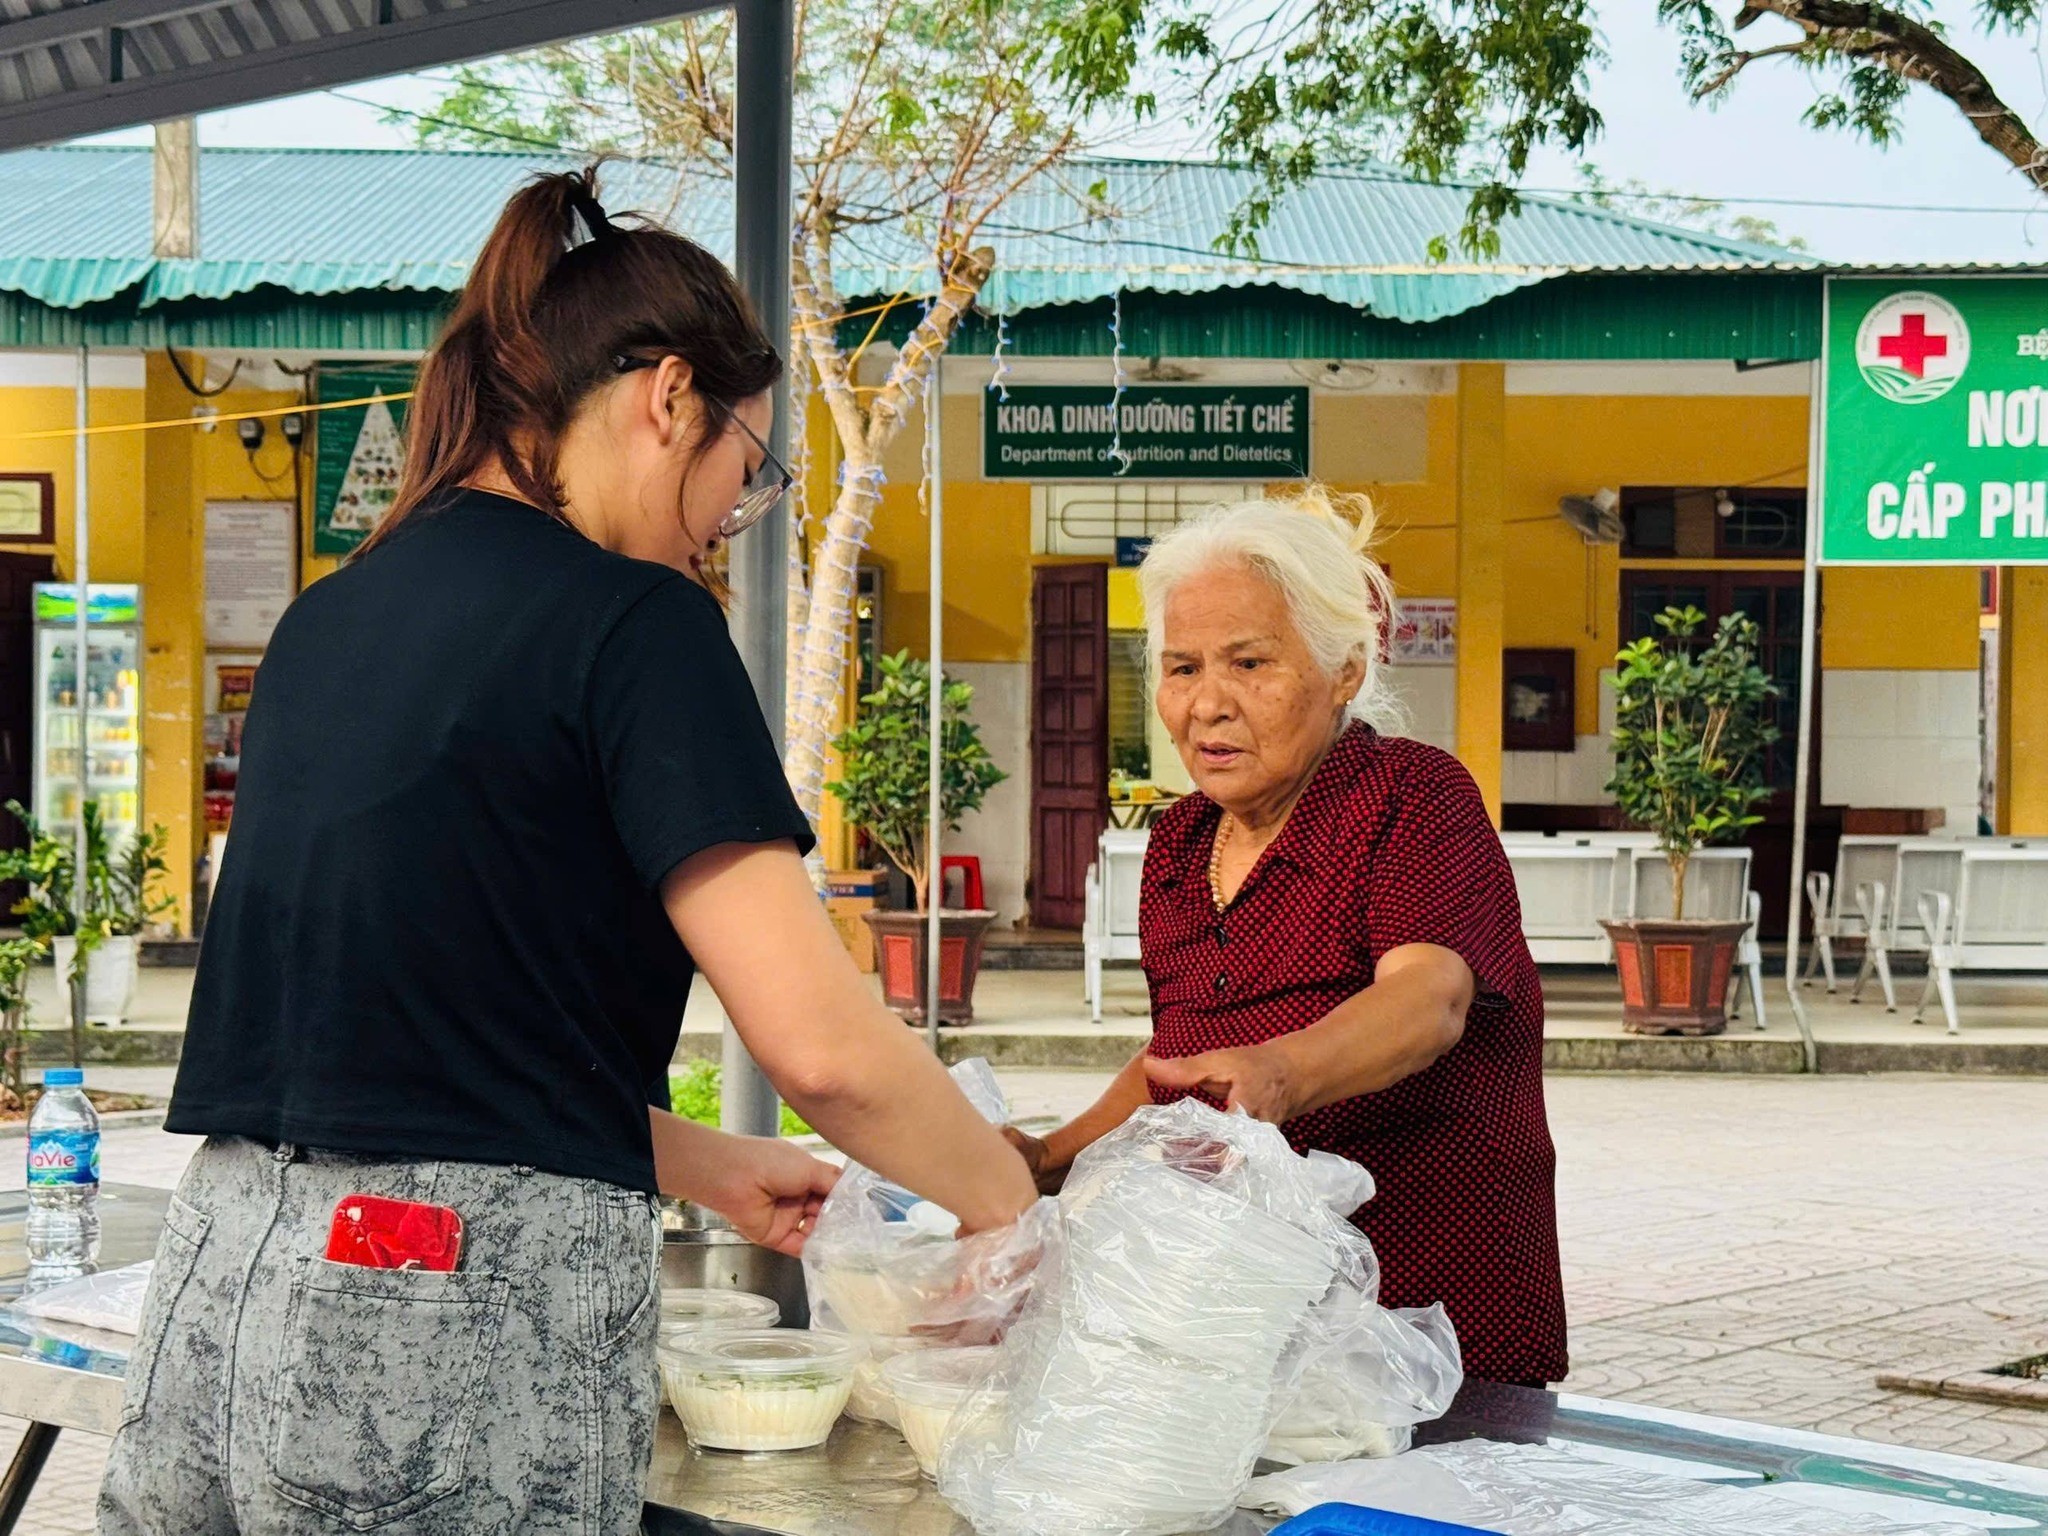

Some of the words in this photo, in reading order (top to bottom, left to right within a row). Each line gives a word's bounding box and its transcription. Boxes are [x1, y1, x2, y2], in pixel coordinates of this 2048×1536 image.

[997, 405, 1056, 433] KHOA
[1062, 405, 1114, 433] DINH
[1121, 397, 1195, 433] DƯỠNG
[1201, 395, 1246, 433] TIẾT
[1252, 395, 1296, 433] CHẾ
[1001, 445, 1093, 465] Department
[1116, 444, 1184, 461] utrition
[1190, 445, 1218, 461] and
[1223, 445, 1292, 461] Dietetics
[1867, 461, 1966, 540] CẤP
[1980, 481, 2048, 538] PH
